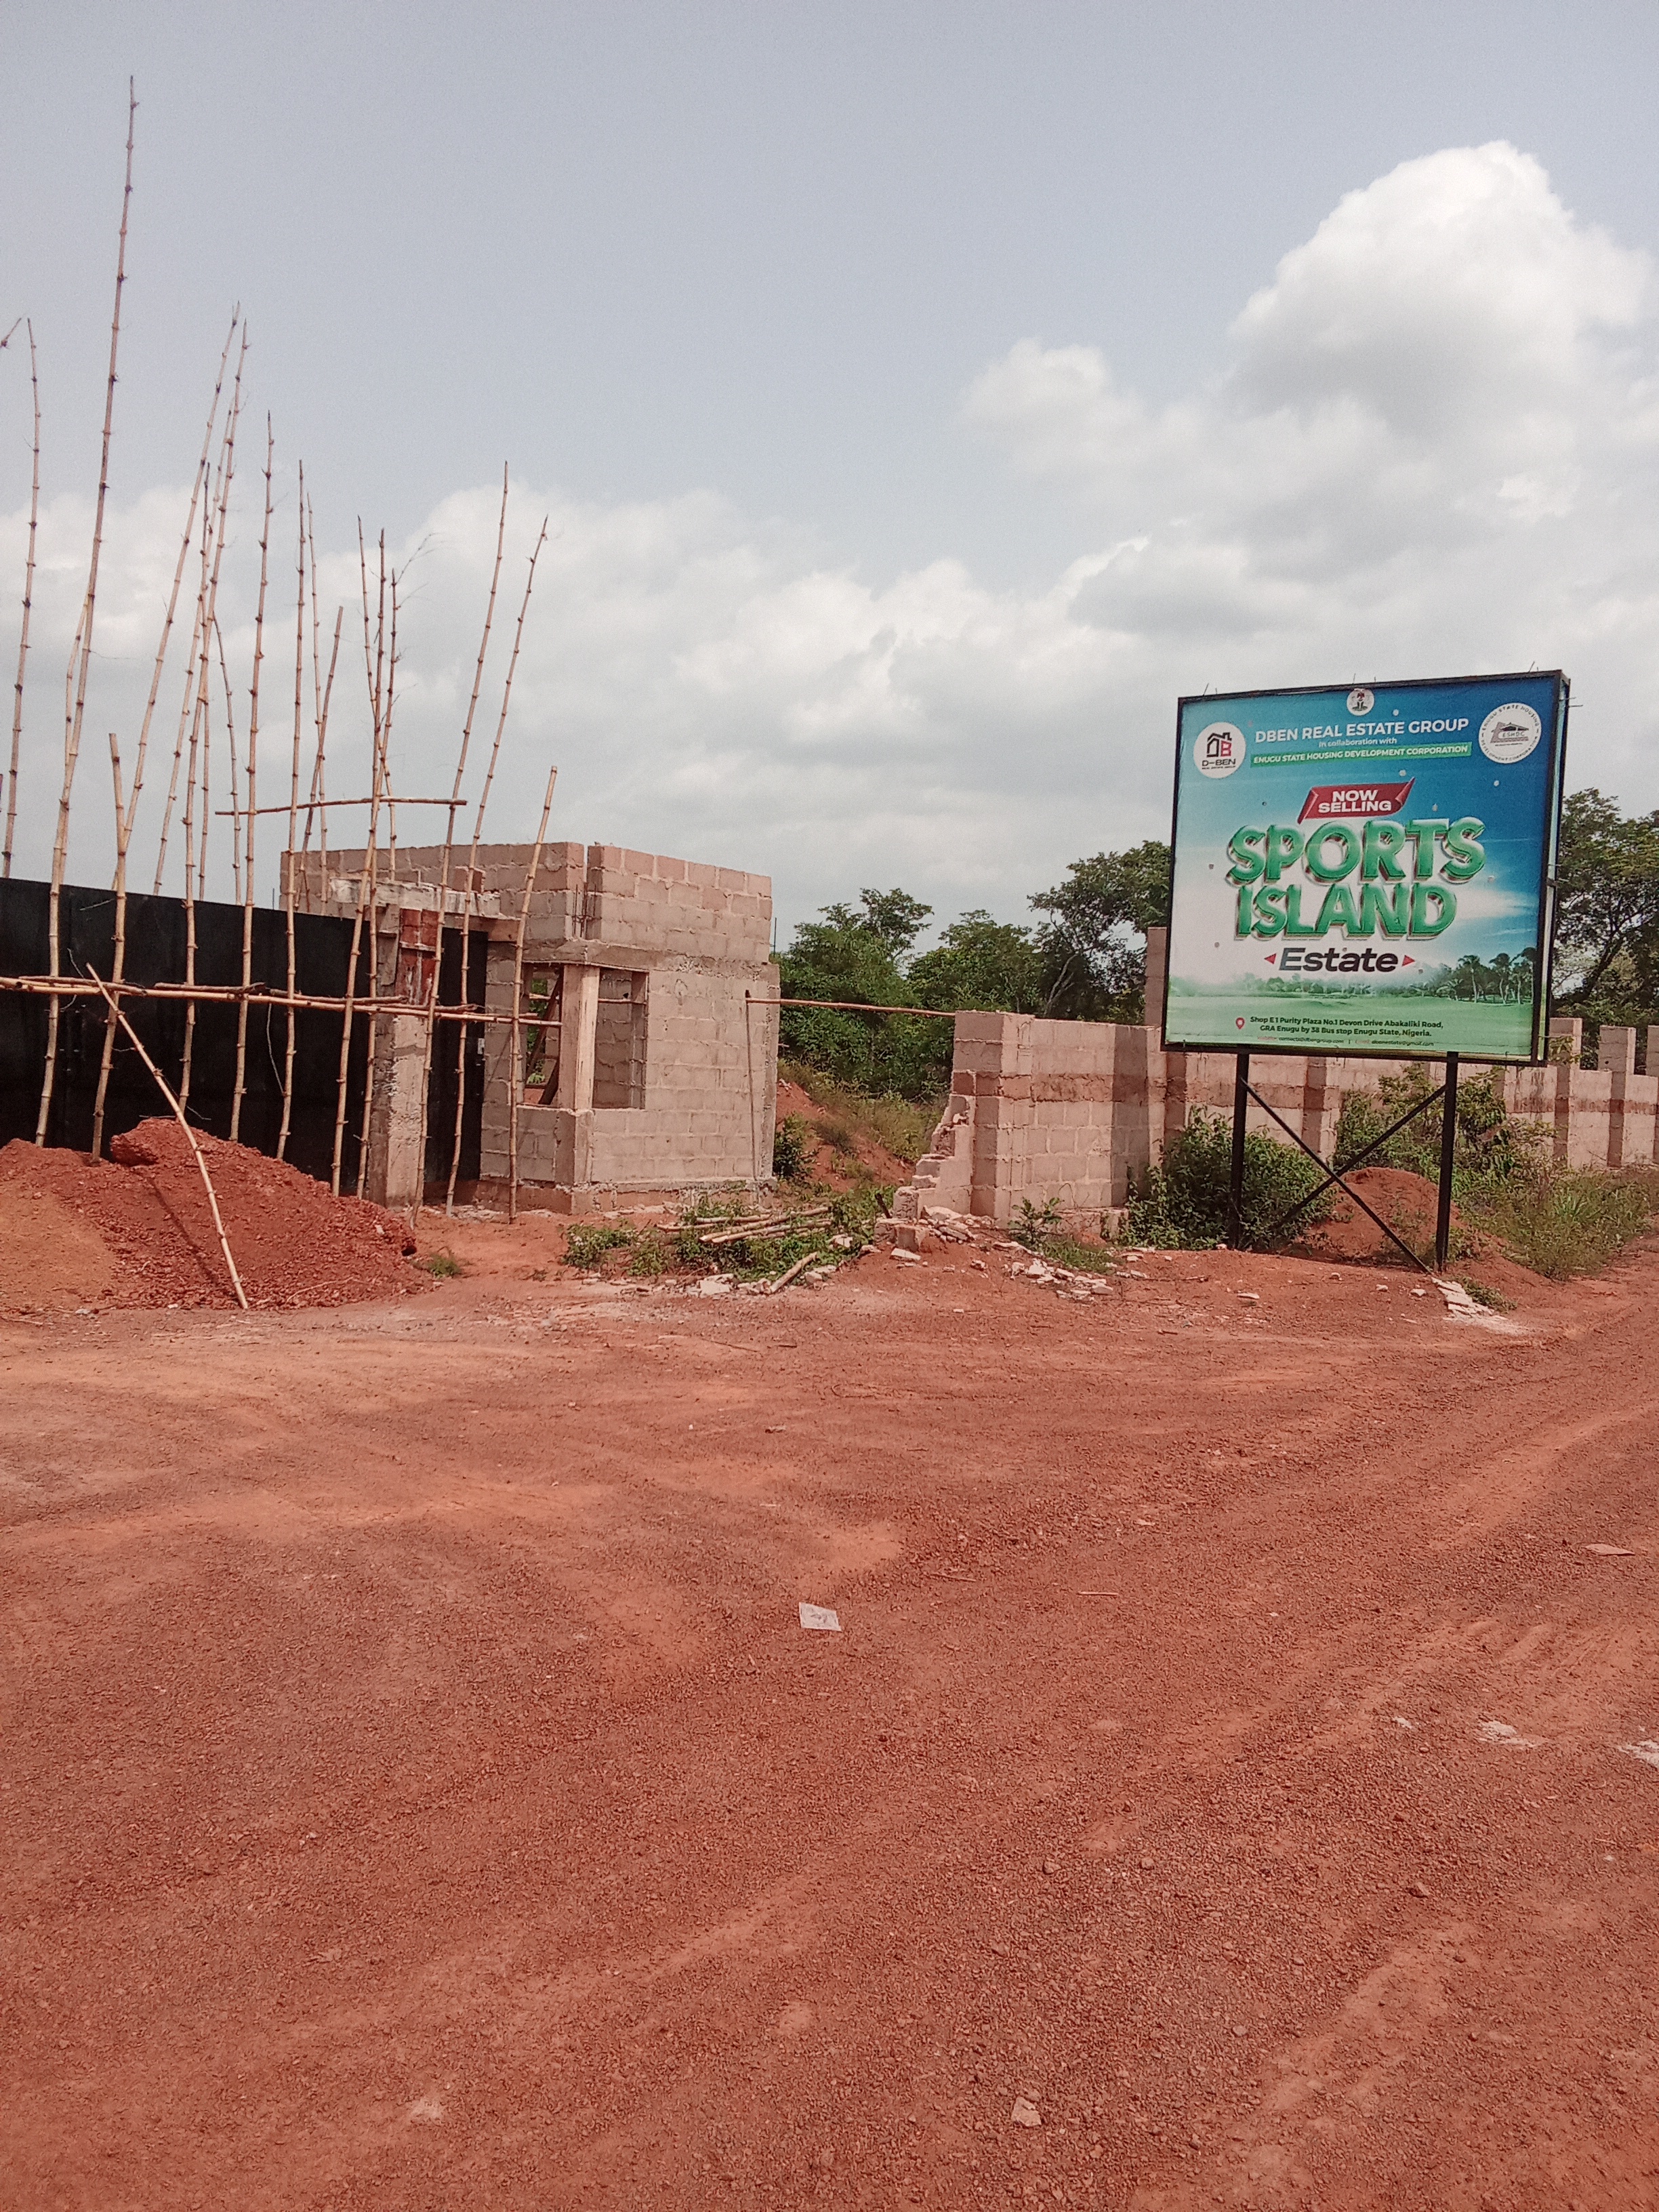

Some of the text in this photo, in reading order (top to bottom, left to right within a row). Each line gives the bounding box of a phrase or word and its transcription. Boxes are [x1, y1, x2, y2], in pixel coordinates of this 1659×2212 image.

[1255, 718, 1469, 743] DBEN REAL ESTATE GROUP
[1328, 738, 1378, 747] collaboration
[1378, 737, 1397, 745] with
[1254, 745, 1468, 764] ENUGU STATE HOUSING DEVELOPMENT CORPORATION
[1332, 790, 1378, 802] NOW
[1318, 800, 1392, 813] SELLING
[1226, 817, 1487, 886] SPORTS
[1234, 882, 1457, 941] ISLAND
[1278, 947, 1399, 972] Estate
[1422, 1021, 1443, 1029] Road,
